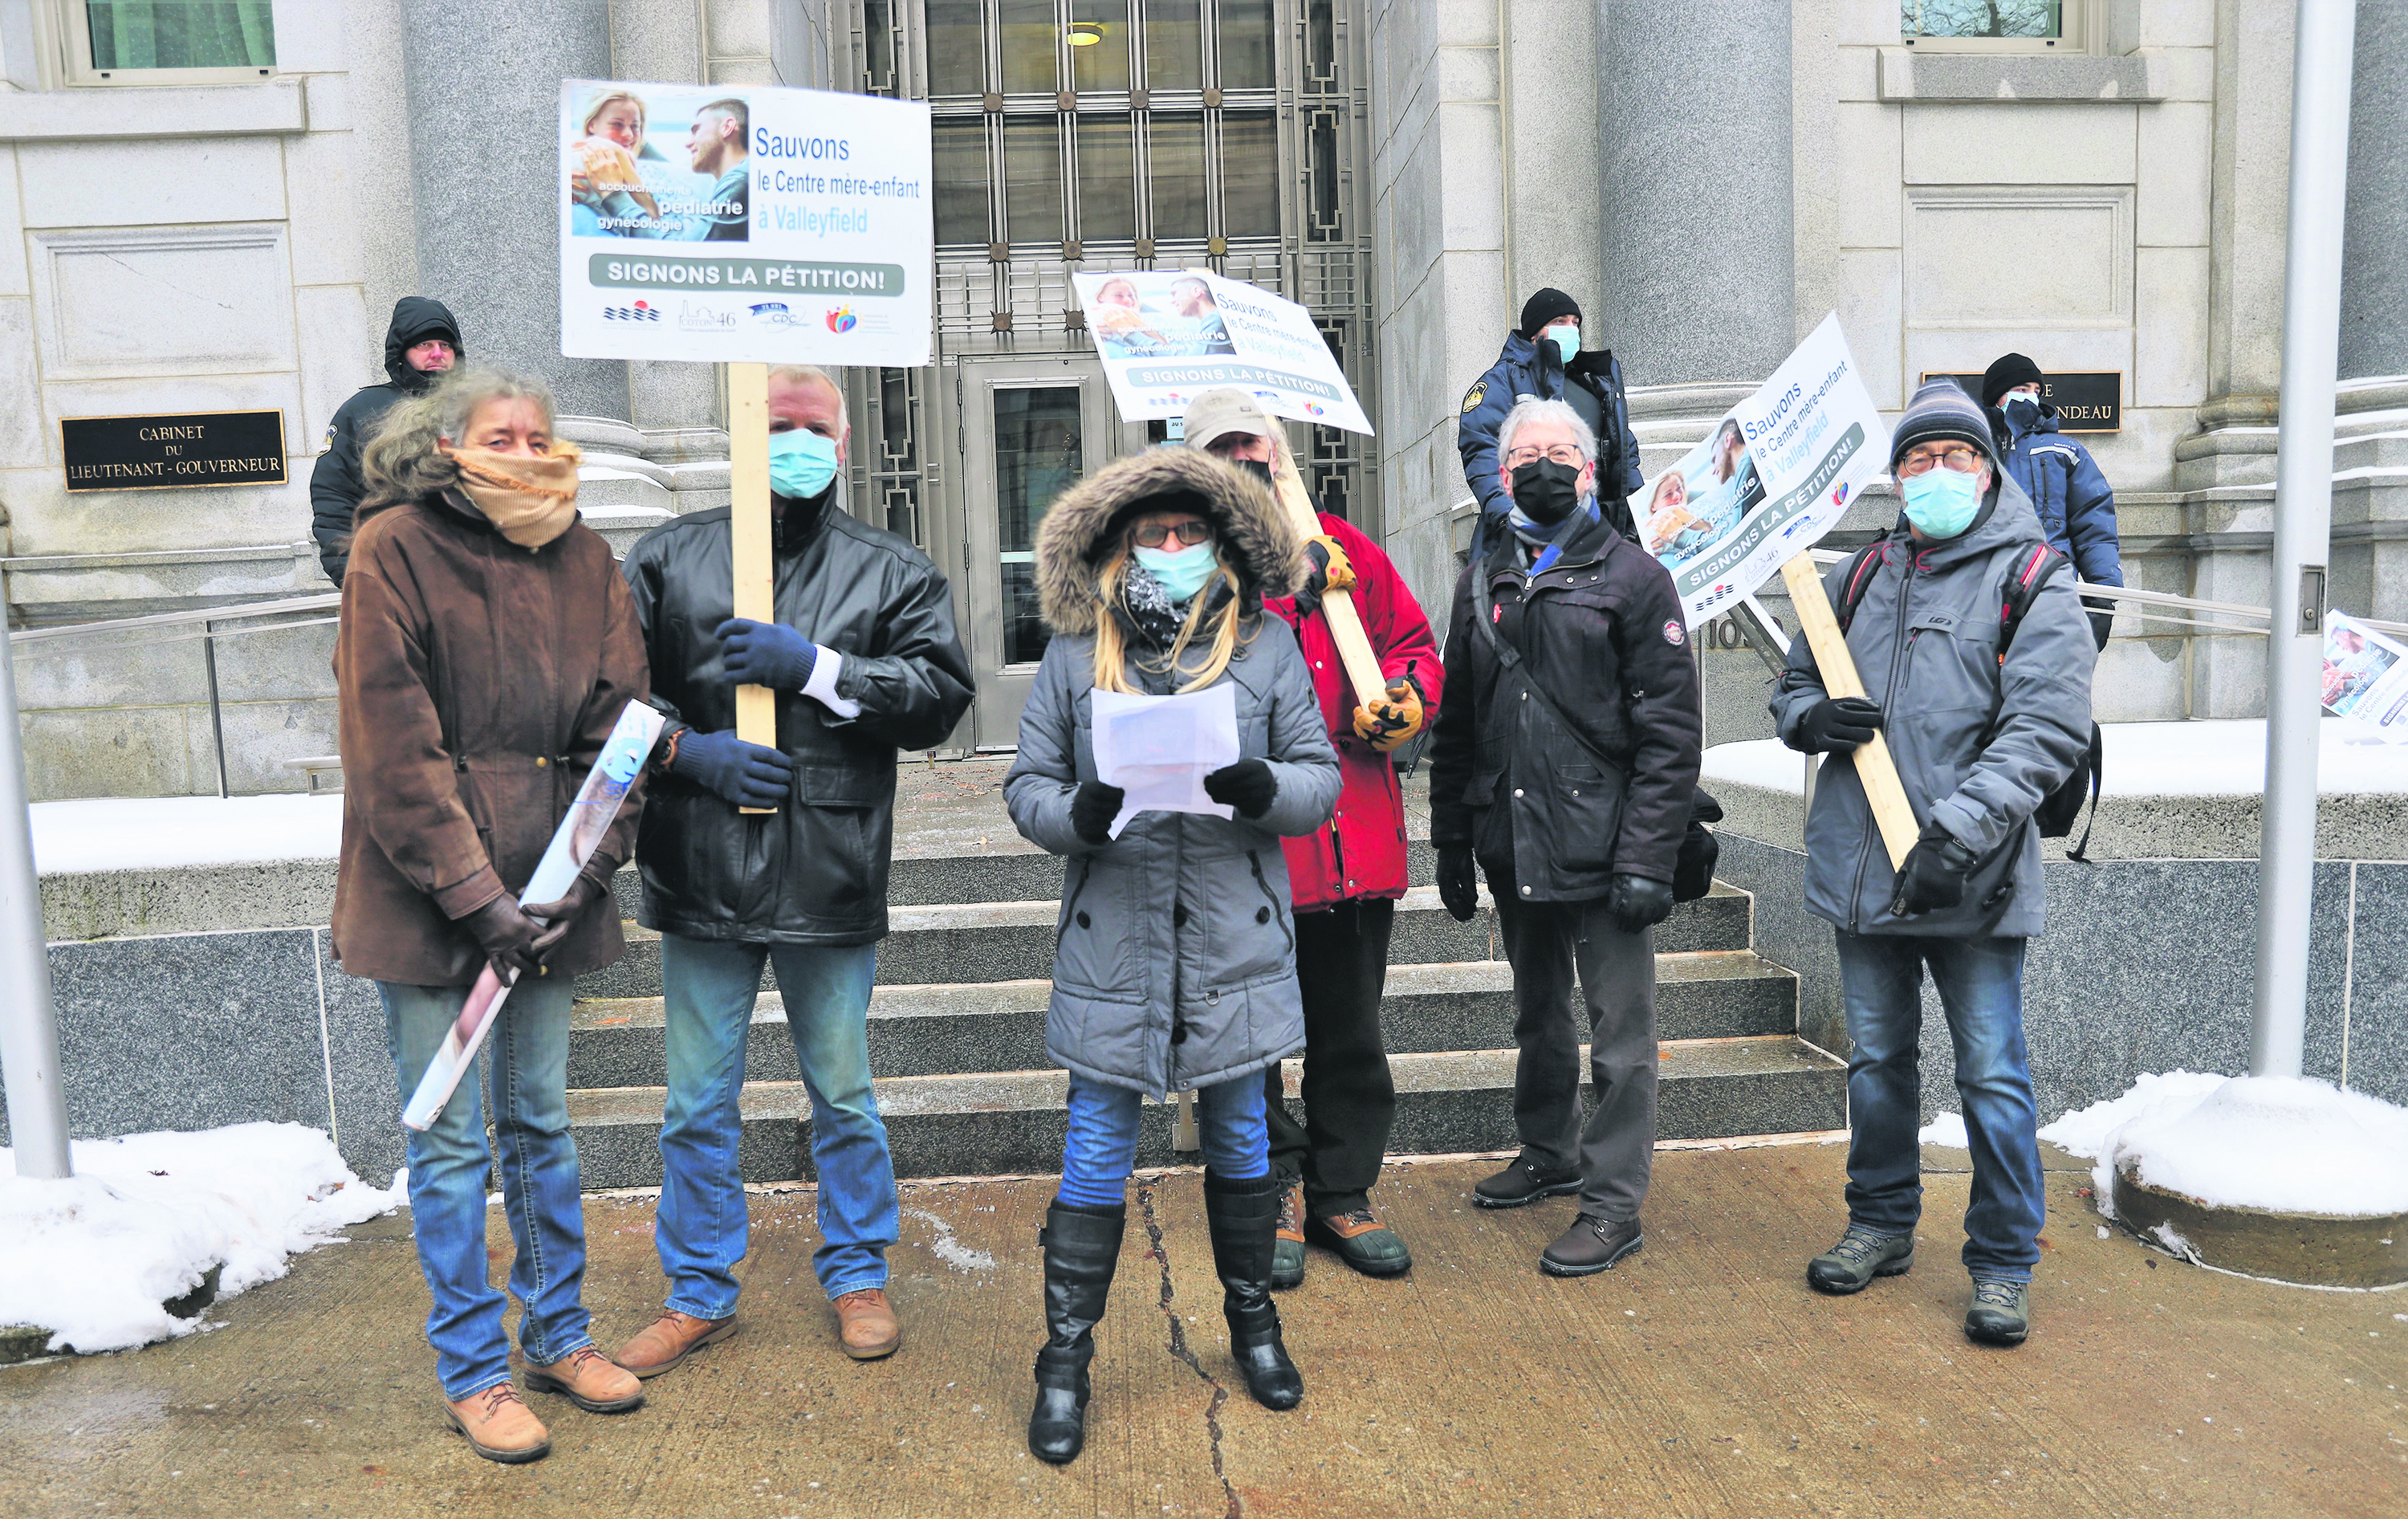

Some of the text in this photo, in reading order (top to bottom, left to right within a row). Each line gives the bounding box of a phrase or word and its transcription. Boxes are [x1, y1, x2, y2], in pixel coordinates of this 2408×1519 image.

[756, 128, 849, 161] Sauvons
[598, 182, 692, 196] accouchements
[759, 169, 920, 198] le Centre mère-enfant
[659, 198, 743, 216] pédiatrie
[759, 204, 868, 238] à Valleyfield
[597, 216, 682, 232] gynécologie
[608, 262, 885, 290] SIGNONS LA PÉTITION!
[717, 312, 736, 328] 46
[772, 314, 797, 324] CDC
[1217, 293, 1278, 322] Sauvons
[1226, 316, 1238, 328] le
[1239, 317, 1271, 336] Centre
[1142, 369, 1226, 383] SIGNONS
[1229, 368, 1253, 381] LA
[1255, 370, 1331, 397] PÉTITION!
[1745, 383, 1801, 440] Sauvons
[1755, 360, 1847, 461] le Centre mère-enfant
[140, 426, 204, 441] CABINET
[1766, 409, 1828, 482] à Valleyfield
[165, 446, 182, 456] DU
[1690, 528, 1759, 586] SIGNONS
[1761, 510, 1783, 531] LA
[1784, 438, 1853, 513] PÉTITION!
[1709, 477, 1756, 526] pédiatrie
[2352, 689, 2378, 716] Sauvons
[2365, 692, 2386, 713] Centre
